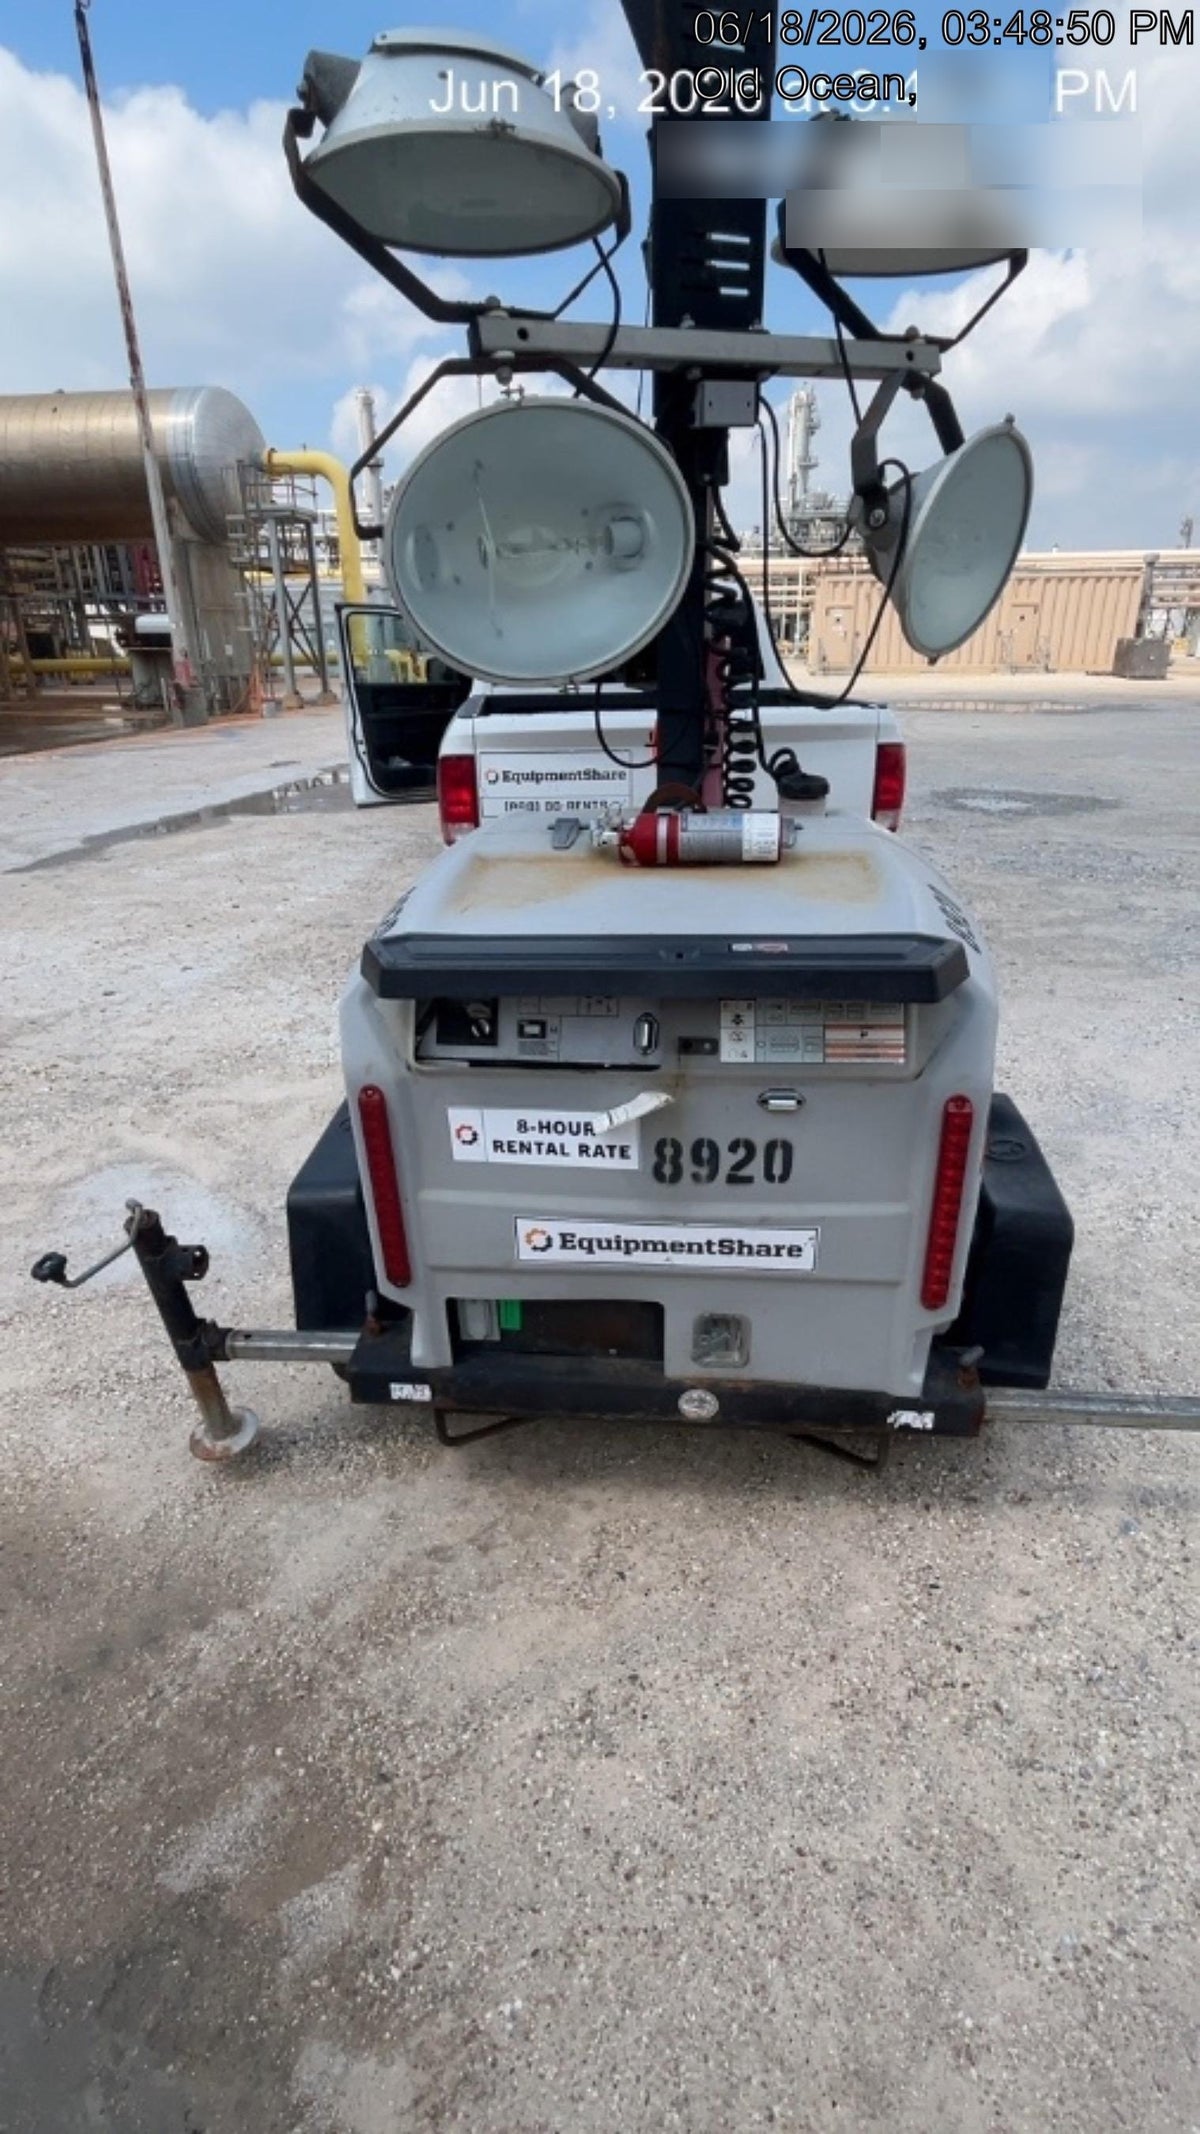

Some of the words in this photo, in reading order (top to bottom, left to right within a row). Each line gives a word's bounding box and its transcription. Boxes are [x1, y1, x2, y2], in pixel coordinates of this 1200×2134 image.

[501, 768, 627, 785] EquipmentShare
[516, 1118, 597, 1137] 8-HOUR
[492, 1139, 570, 1158] RENTAL
[578, 1143, 632, 1160] RATE
[652, 1137, 794, 1185] 8920
[558, 1232, 804, 1259] EquipmentShare
